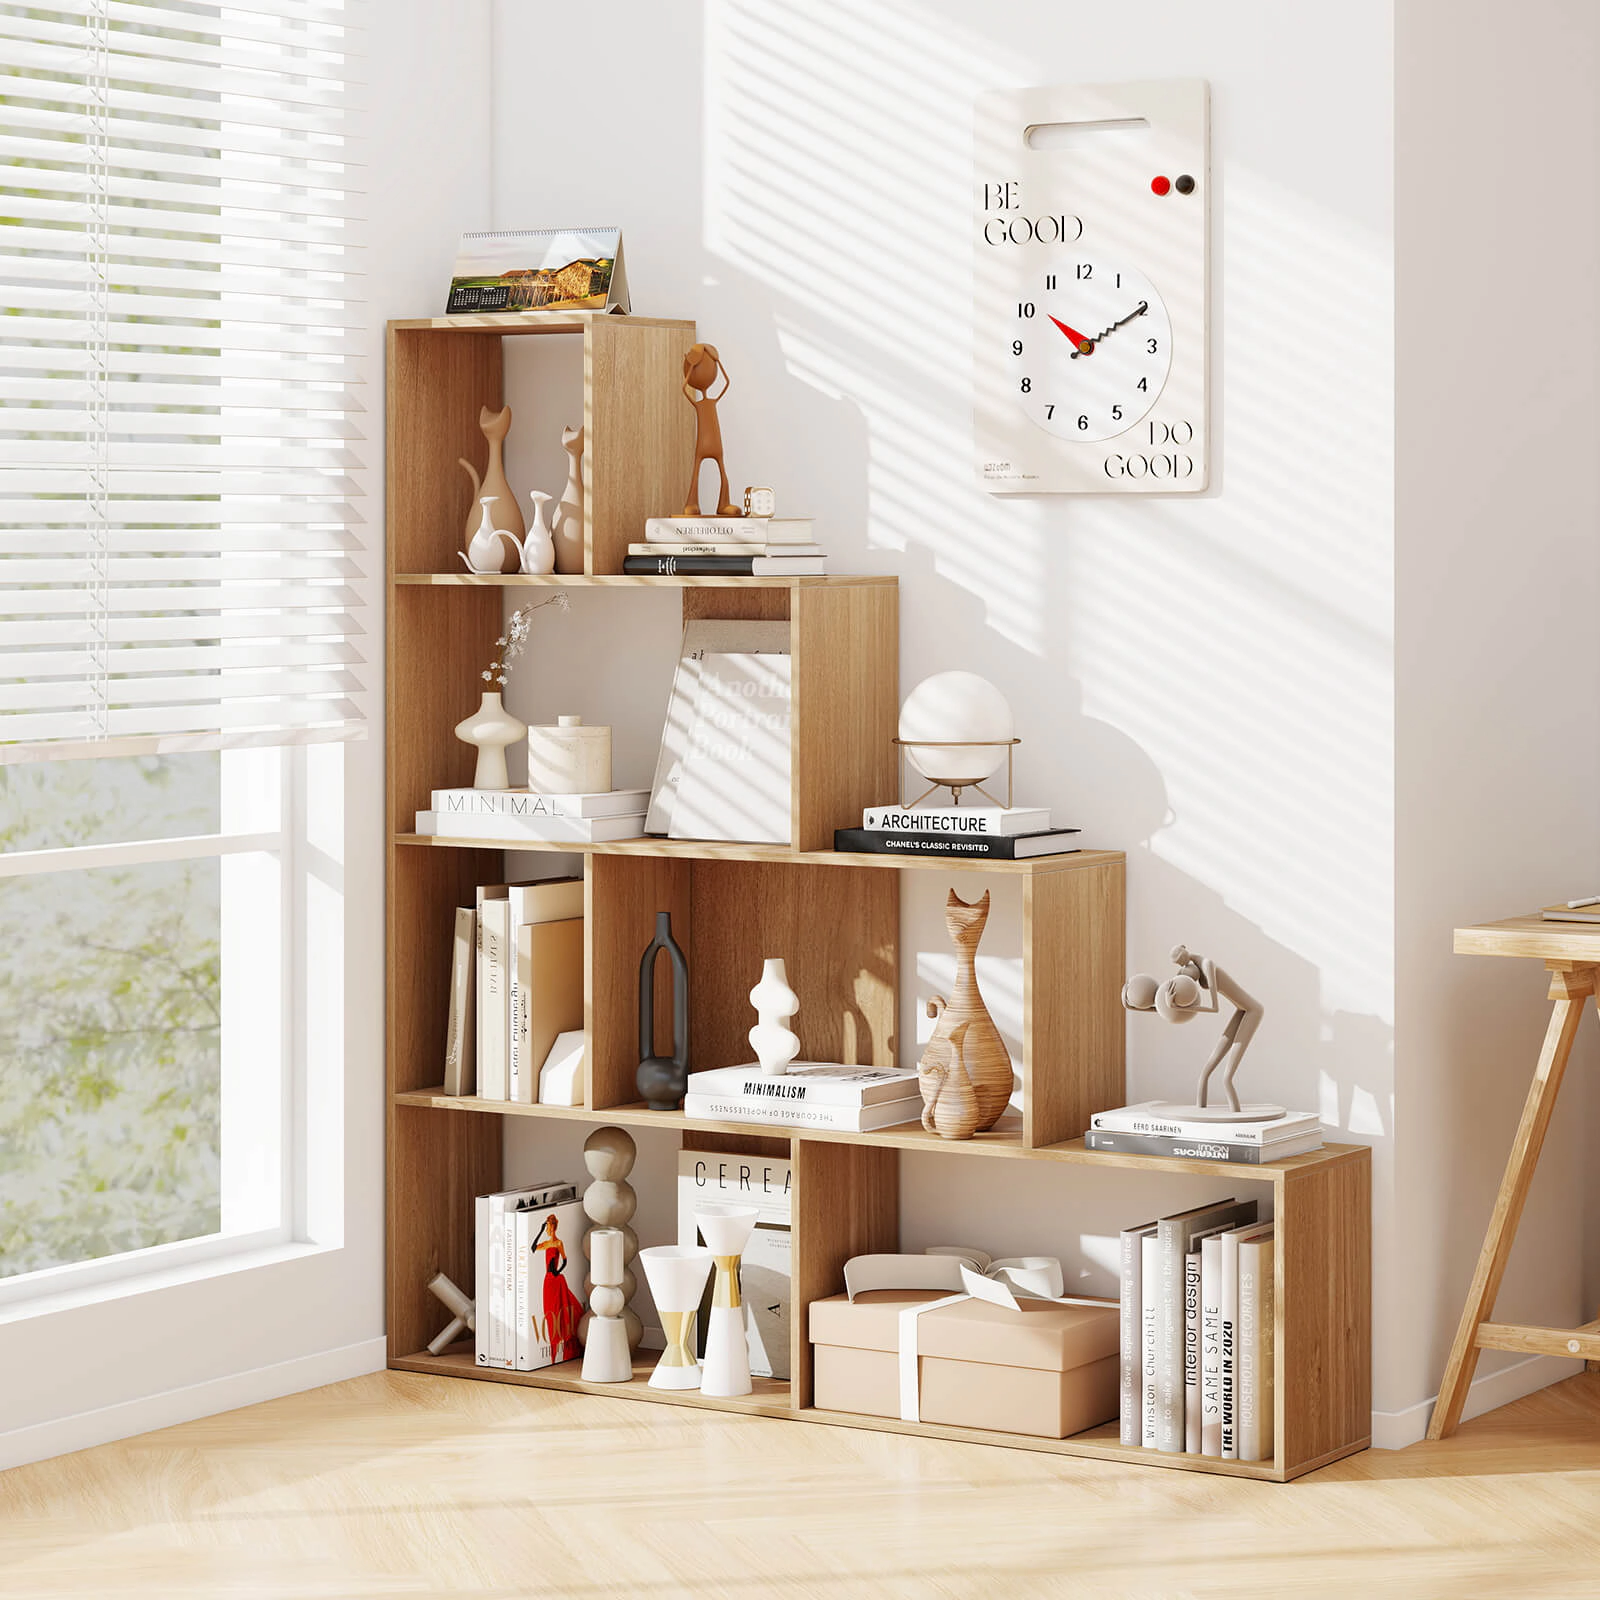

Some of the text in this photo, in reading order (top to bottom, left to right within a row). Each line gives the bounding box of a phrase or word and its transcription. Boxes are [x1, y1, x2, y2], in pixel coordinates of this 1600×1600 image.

[984, 181, 1020, 211] BE
[984, 215, 1084, 246] GOOD
[1076, 263, 1093, 280] 12
[1046, 275, 1056, 290] 11
[1116, 273, 1121, 289] 1
[1018, 302, 1036, 318] 10
[1012, 340, 1023, 356] 9
[1147, 338, 1158, 354] 3
[1021, 377, 1032, 393] 8
[1137, 377, 1148, 392] 4
[1045, 405, 1055, 420] 7
[1112, 405, 1123, 420] 5
[1077, 415, 1089, 430] 6
[1150, 420, 1193, 446] DO
[1104, 454, 1193, 479] GOOD
[447, 795, 565, 817] MINIMAL
[881, 814, 987, 832] ARCHITECTURE
[885, 840, 989, 852] CHANEL'S CLASSIC REVISITED
[743, 1081, 807, 1100] MINIMALISM
[1133, 1122, 1182, 1134] EERO SAARINEN
[1172, 1147, 1230, 1160] INTERIORS
[1184, 1261, 1201, 1386] Interior design
[1205, 1306, 1218, 1414] SAME SAME
[1145, 1306, 1155, 1439] Winston Churchill
[1223, 1321, 1233, 1452] THE WORLD IN 2020
[1241, 1354, 1253, 1428] HOUSEHOLD
